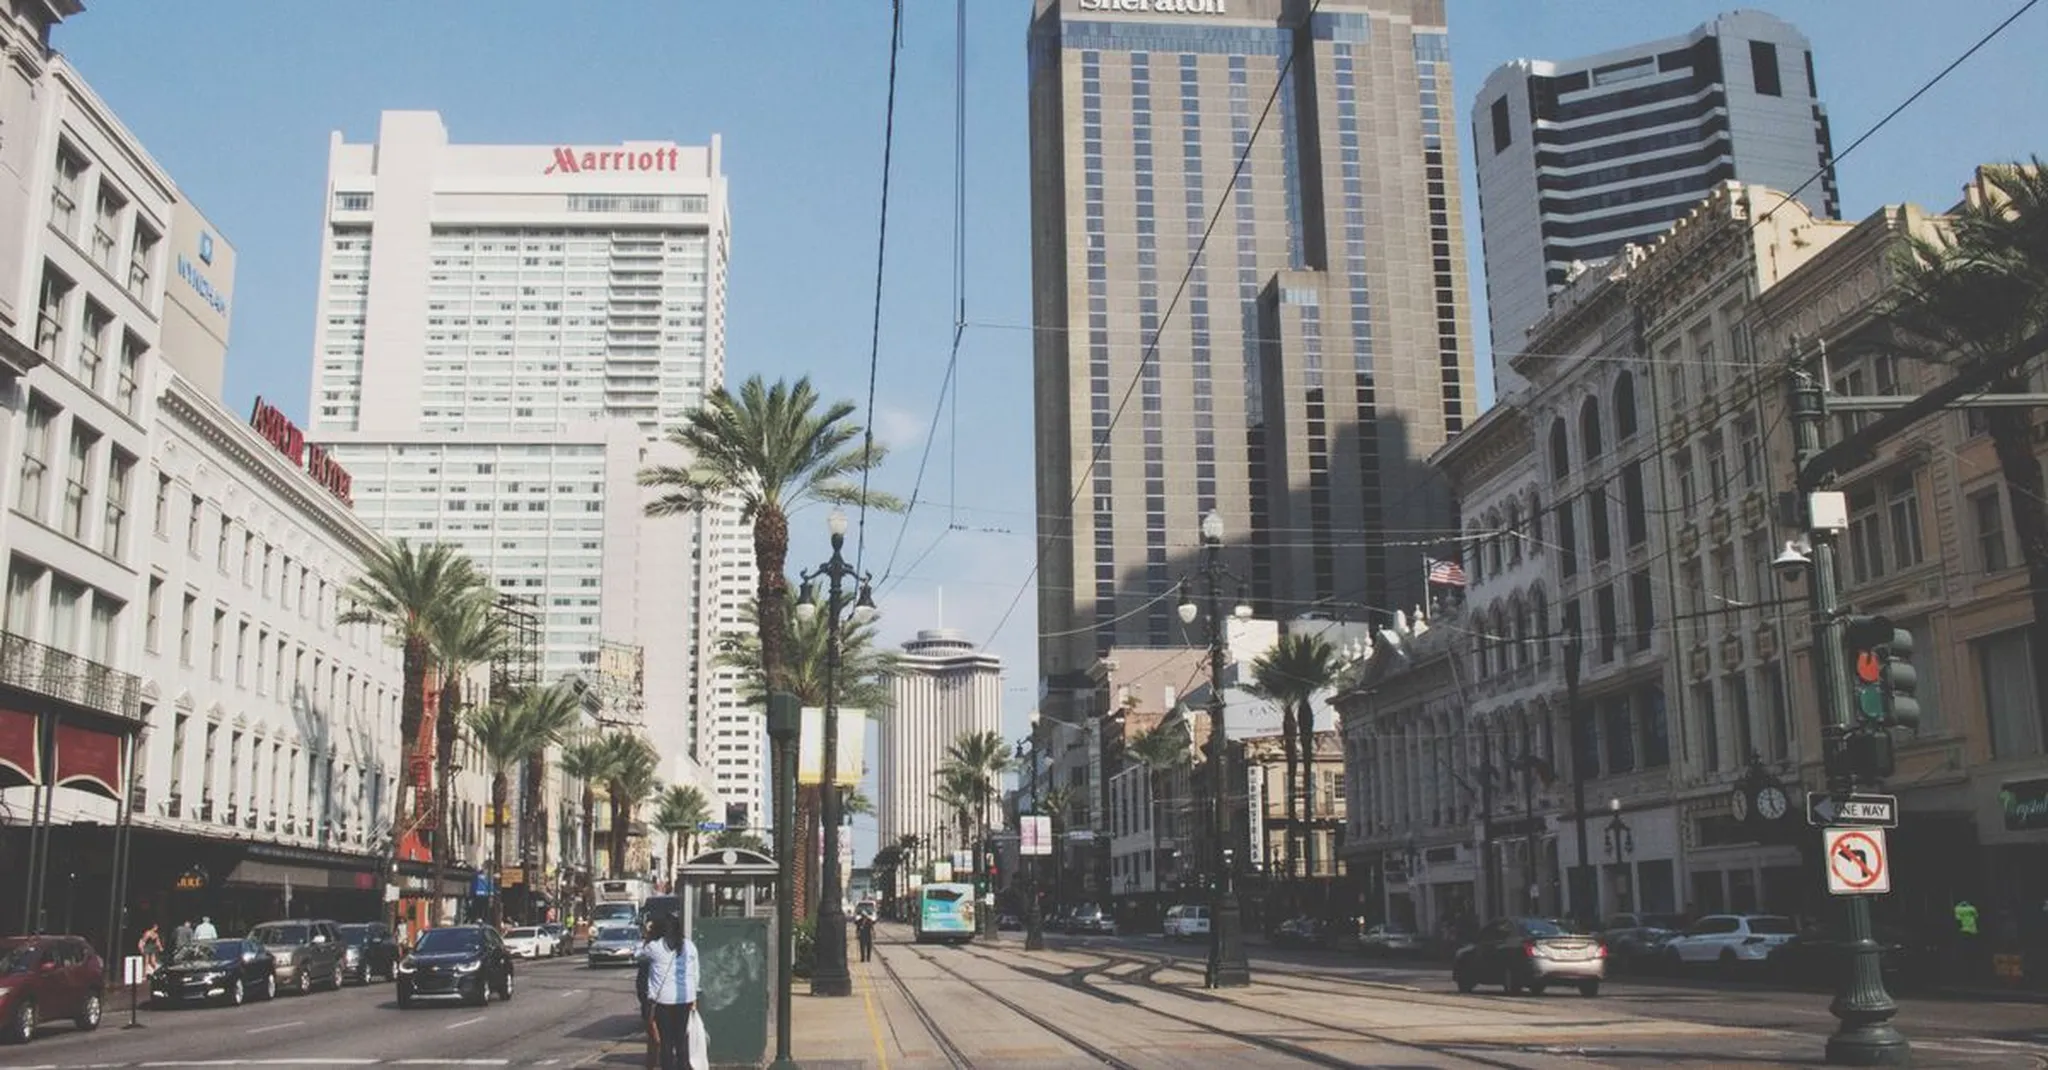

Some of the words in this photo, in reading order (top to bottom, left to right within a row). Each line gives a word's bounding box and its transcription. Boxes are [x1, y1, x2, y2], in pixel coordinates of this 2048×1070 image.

[544, 147, 677, 175] Marriott
[307, 441, 354, 509] HOTEL
[1861, 804, 1886, 817] WAY
